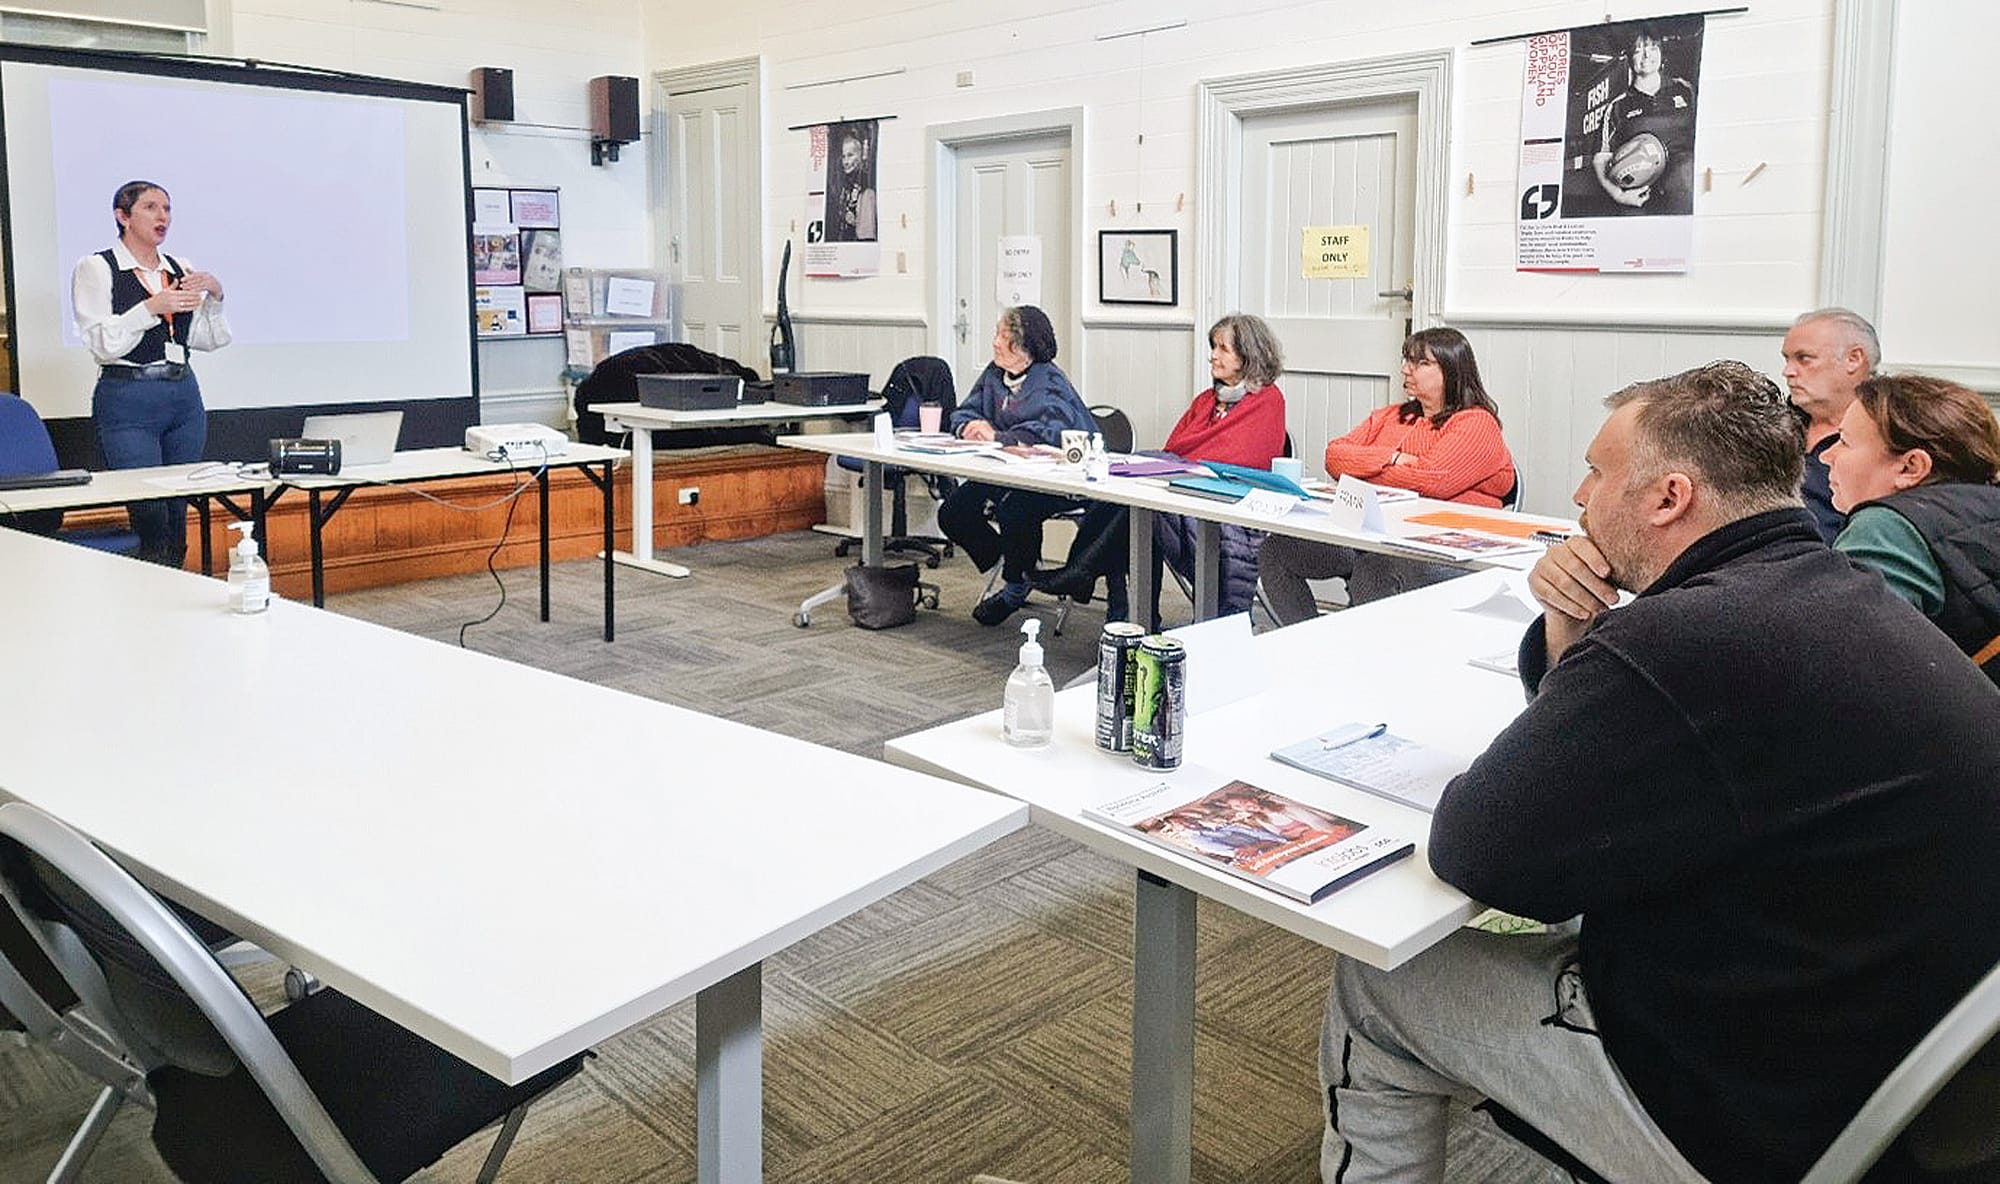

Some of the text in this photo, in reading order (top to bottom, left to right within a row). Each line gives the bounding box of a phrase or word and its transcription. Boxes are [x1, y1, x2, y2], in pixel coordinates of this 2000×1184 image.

[1527, 35, 1538, 84] WOMEN
[1535, 35, 1549, 107] GIPPSLAND
[1546, 34, 1558, 97] OF SOUTH
[1557, 33, 1568, 85] STORIES
[1587, 77, 1610, 111] FISH
[1320, 235, 1350, 246] STAFF
[1322, 252, 1349, 263] ONLY
